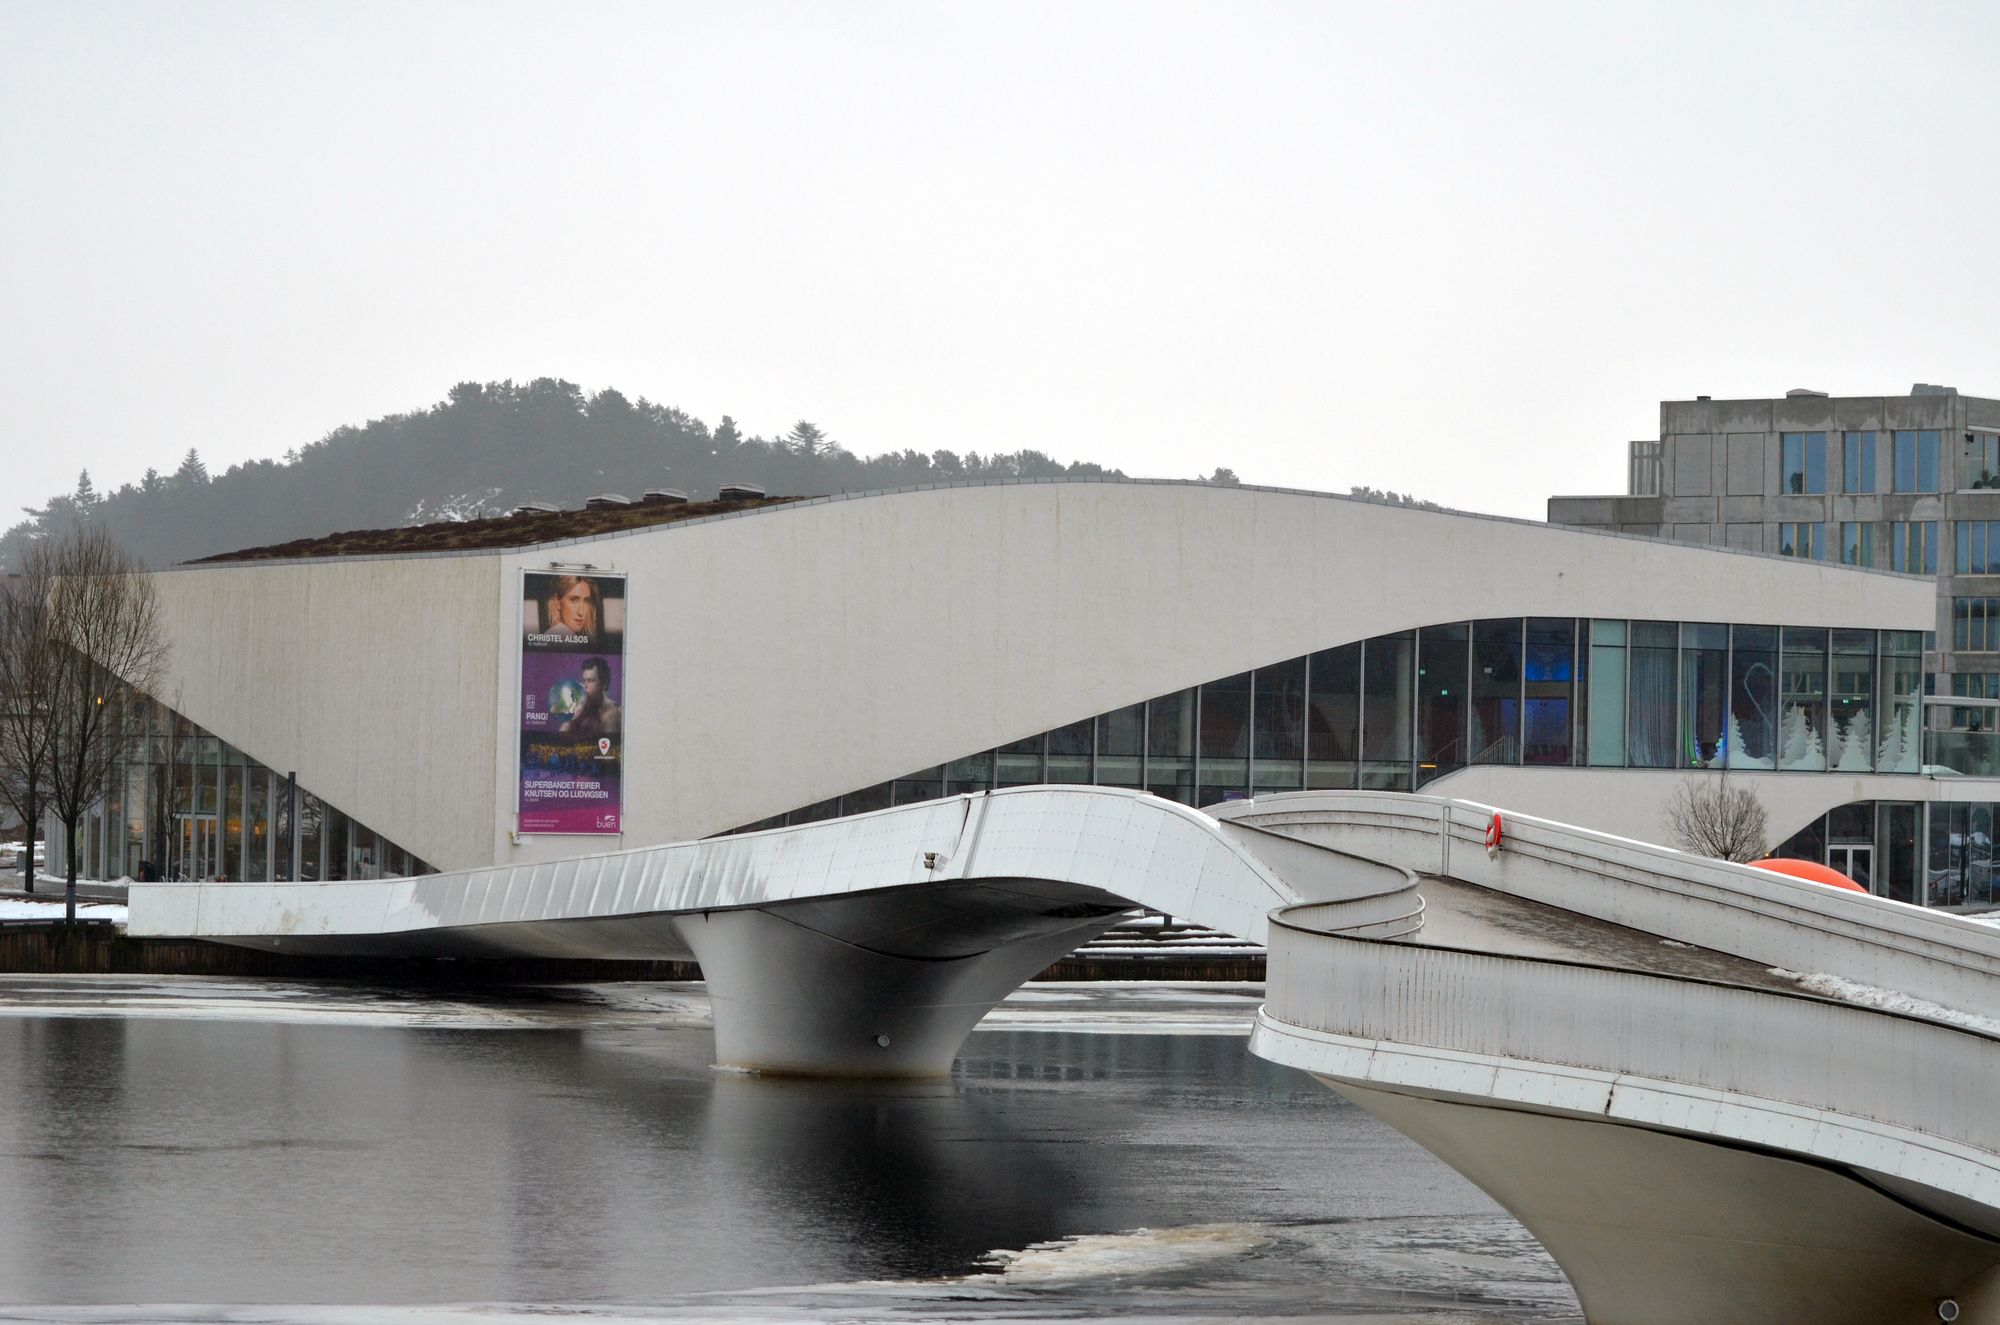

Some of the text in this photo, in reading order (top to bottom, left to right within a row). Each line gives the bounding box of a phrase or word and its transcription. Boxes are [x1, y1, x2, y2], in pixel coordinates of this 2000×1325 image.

[528, 633, 589, 644] CHRISTEL ALSOS
[526, 712, 548, 720] PANG!
[524, 780, 601, 790] SUPERBANDET FEIRER
[524, 789, 609, 799] KNUTSEN OG LUDVIGSEN
